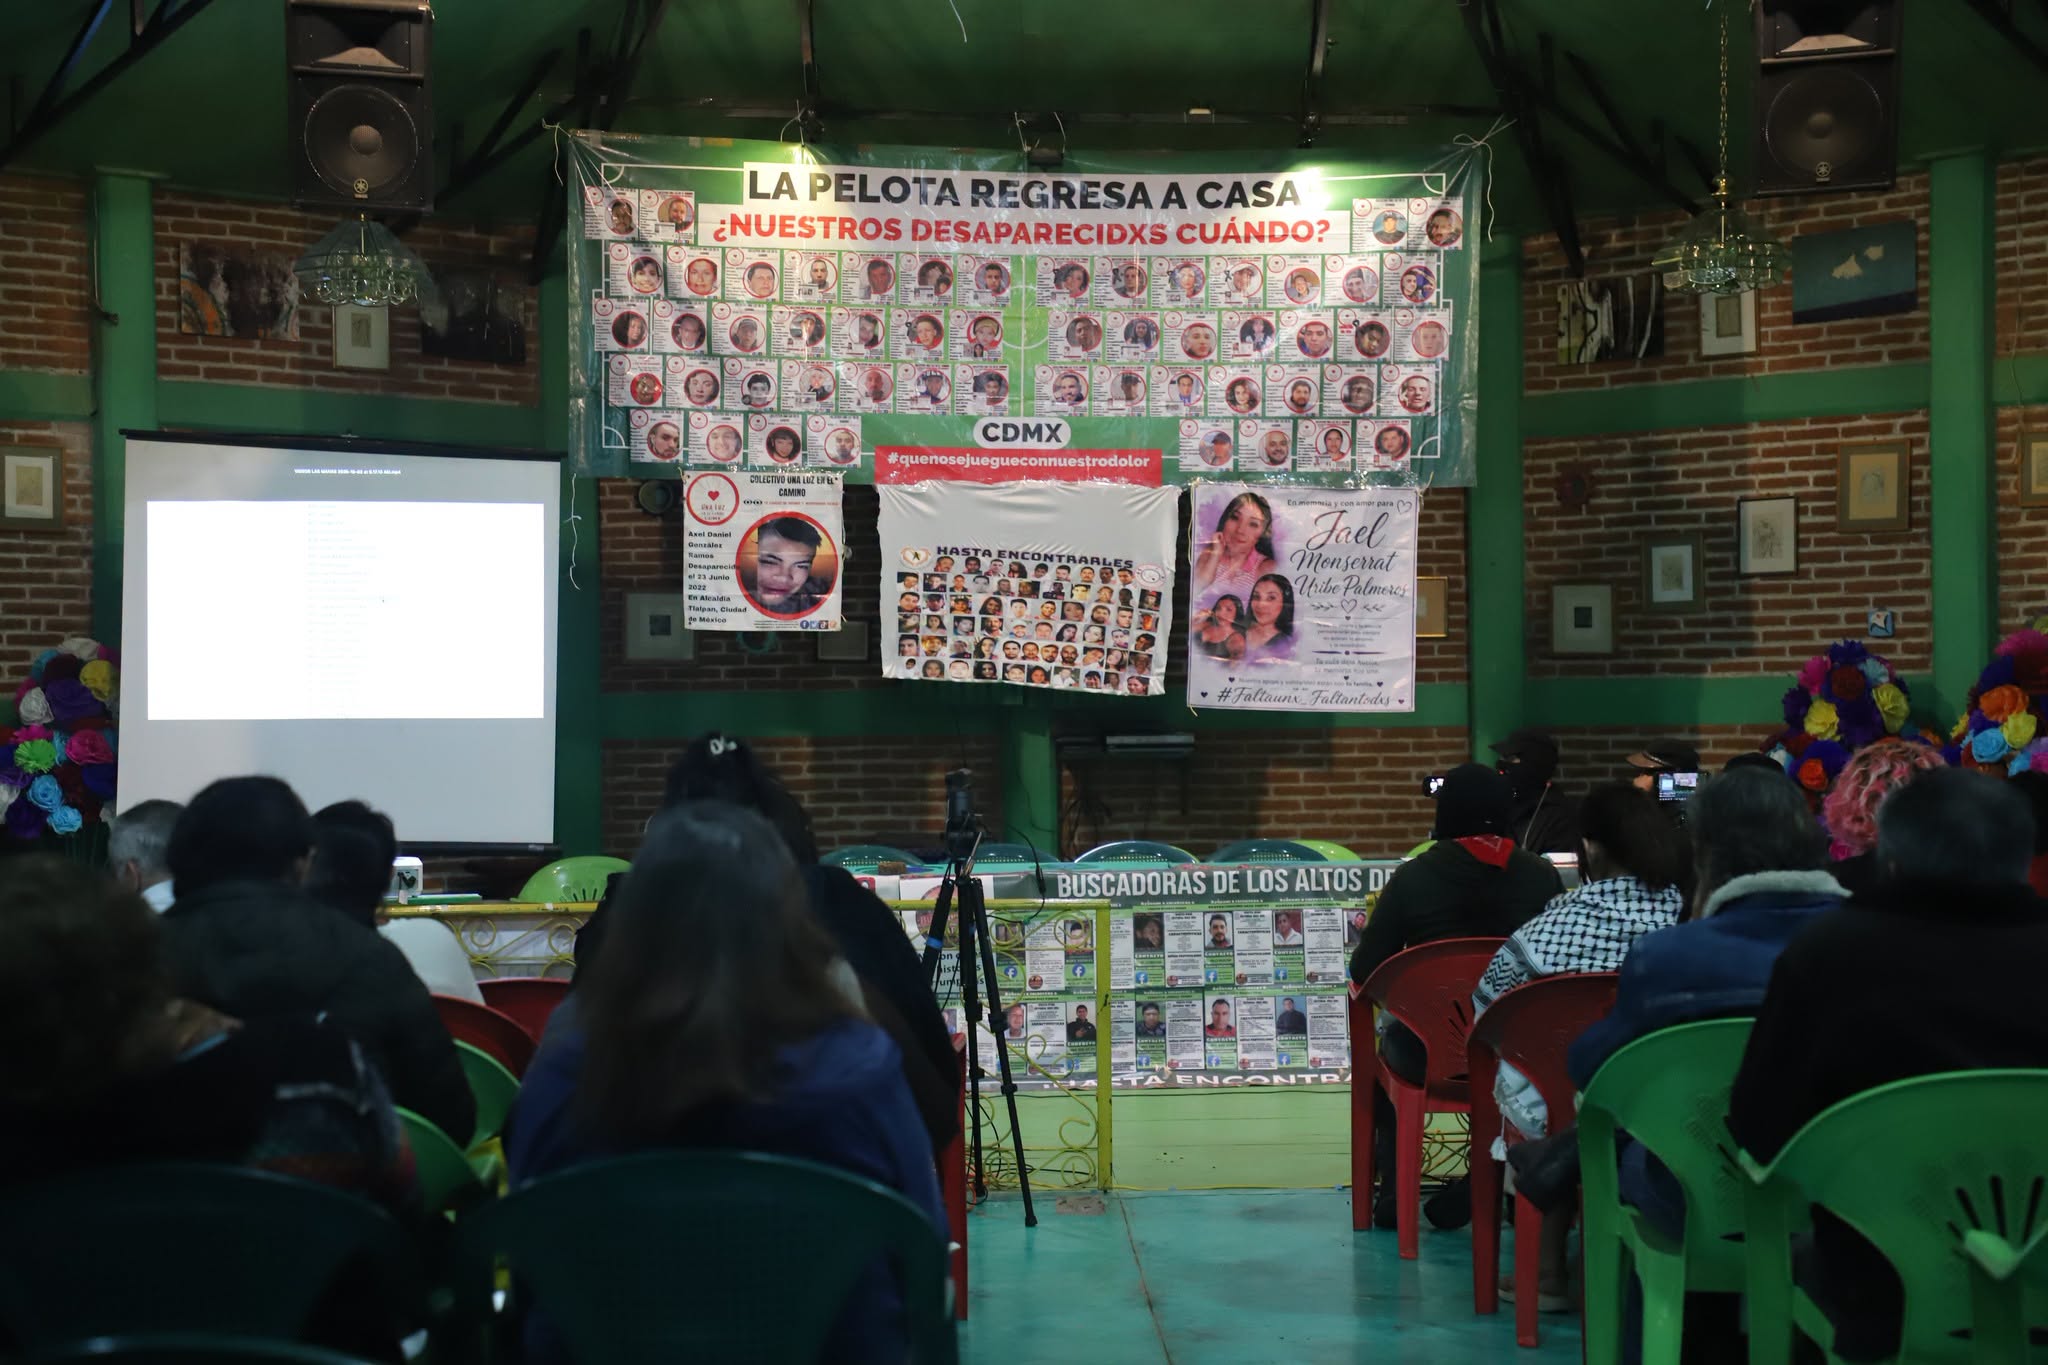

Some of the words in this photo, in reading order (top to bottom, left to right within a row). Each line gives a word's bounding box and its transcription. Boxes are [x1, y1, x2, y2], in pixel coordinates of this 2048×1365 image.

[749, 170, 798, 200] LA
[808, 172, 961, 207] PELOTA
[971, 178, 1153, 210] REGRESA
[1160, 181, 1188, 209] A
[1196, 180, 1301, 209] CASA
[713, 213, 902, 242] ¿NUESTROS
[911, 218, 1168, 245] DESAPARECIDXS
[1175, 216, 1331, 245] CUÁNDO?
[981, 422, 1063, 443] CDMX
[887, 451, 1150, 469] #quenosejuegueconnuestrodolor
[749, 475, 785, 485] COLECTIVO
[787, 475, 801, 485] UNA
[803, 475, 815, 485] LUZ
[778, 488, 806, 497] CAMINO
[1376, 500, 1394, 508] para
[1306, 509, 1390, 551] Jael
[936, 545, 993, 558] HASTA
[997, 549, 1134, 570] ENCONTRARLES
[1289, 549, 1401, 574] Monserrat
[1294, 574, 1341, 598] Uribe
[1057, 871, 1207, 898] BUSCADORAS
[1213, 869, 1240, 894] DE
[1246, 868, 1289, 894] LOS
[1295, 867, 1362, 893] ALTOS
